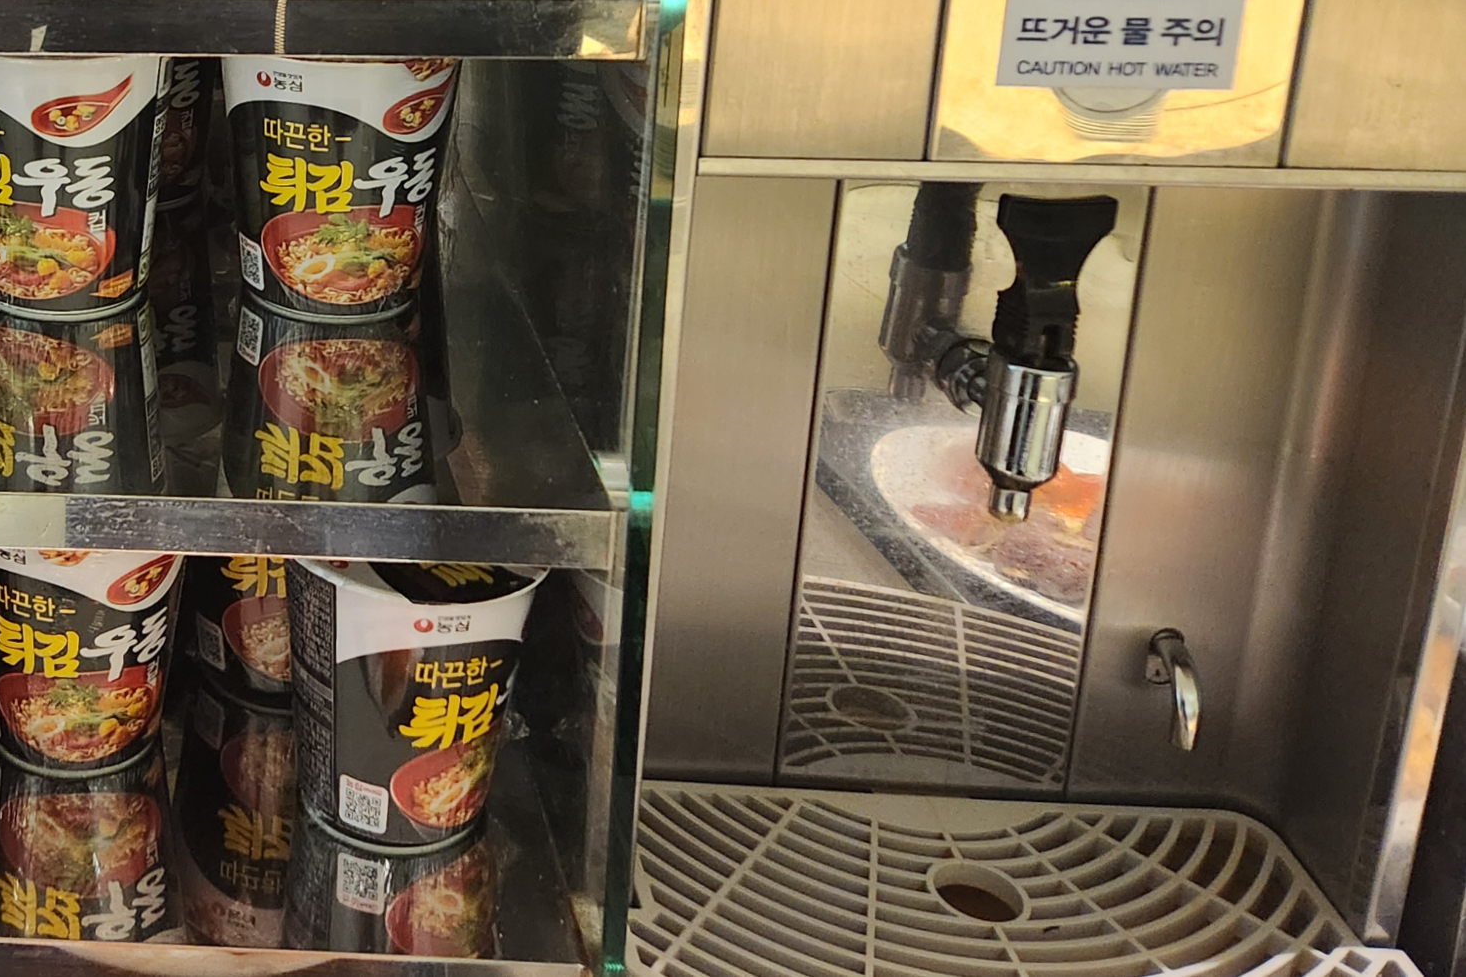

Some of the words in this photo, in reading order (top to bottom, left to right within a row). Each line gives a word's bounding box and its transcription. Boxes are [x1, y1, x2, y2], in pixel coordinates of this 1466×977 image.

[1016, 16, 1112, 46] 뜨거운
[1121, 17, 1154, 47] 물
[1160, 17, 1227, 47] 주의
[1016, 60, 1101, 77] CAUTION
[1107, 61, 1148, 77] HOT
[1154, 61, 1220, 78] WATER
[273, 76, 303, 93] 농심
[398, 675, 508, 750] 튀김
